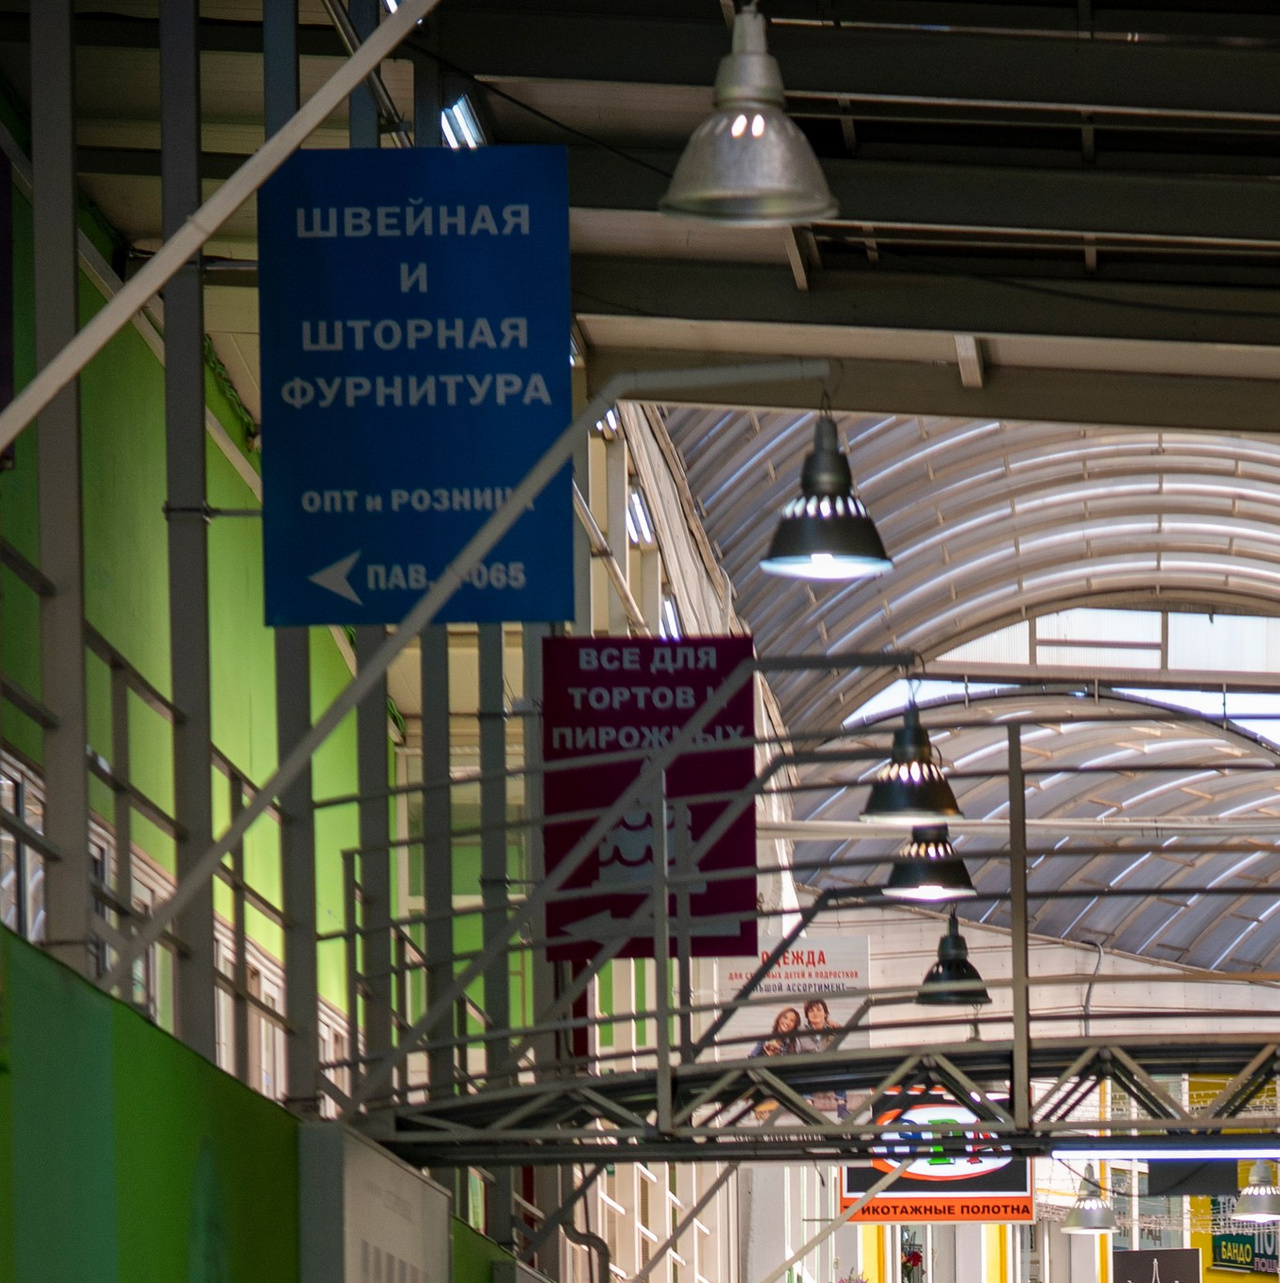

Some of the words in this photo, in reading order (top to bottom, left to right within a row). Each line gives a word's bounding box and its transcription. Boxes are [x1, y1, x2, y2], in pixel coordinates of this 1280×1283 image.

[297, 197, 530, 238] ШВЕЙНАЯ
[400, 262, 428, 293] И
[302, 317, 528, 351] ШТОРНАЯ
[281, 373, 552, 408] ФУРНИТУРА
[301, 490, 358, 512] ОПТ
[391, 487, 535, 512] РОЗНИ
[578, 647, 641, 671] ВСЕ
[650, 646, 717, 674] ДЛЯ
[568, 686, 695, 710] ТОРТОВ
[553, 725, 745, 749] ПИРОЖЫХ
[761, 950, 827, 967] ОЕЖДА
[815, 970, 859, 980] ПОДРОСТКОВ
[745, 983, 783, 994] ЛЬШОЙ
[786, 982, 847, 993] АССОРТИМЕНТ
[843, 1205, 955, 1215] ИКОТАЖНЫЕ
[961, 1204, 1030, 1215] ПОЛОТНА
[1221, 1241, 1252, 1264] БАНДО
